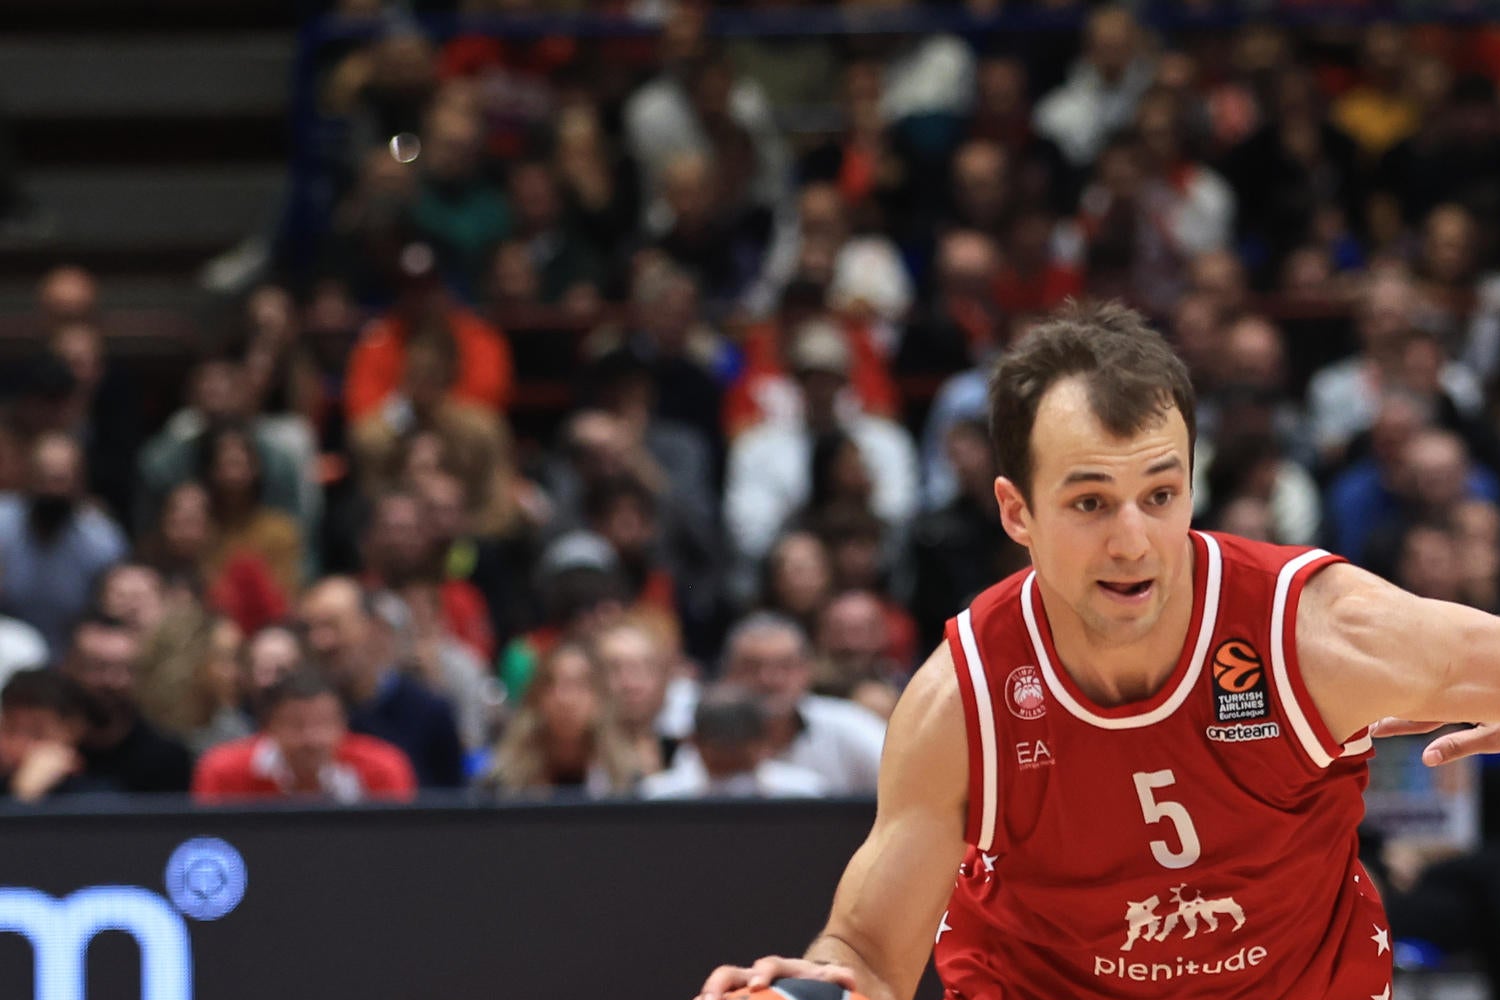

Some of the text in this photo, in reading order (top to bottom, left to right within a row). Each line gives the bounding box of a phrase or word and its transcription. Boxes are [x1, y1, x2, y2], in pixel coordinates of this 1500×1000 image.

[1218, 691, 1263, 704] TURKISH
[1219, 700, 1265, 712] AIRLINES
[1219, 709, 1265, 720] EuroLeague
[1207, 724, 1279, 741] oneteam
[1133, 769, 1200, 869] 5
[1094, 946, 1268, 982] plenitude
